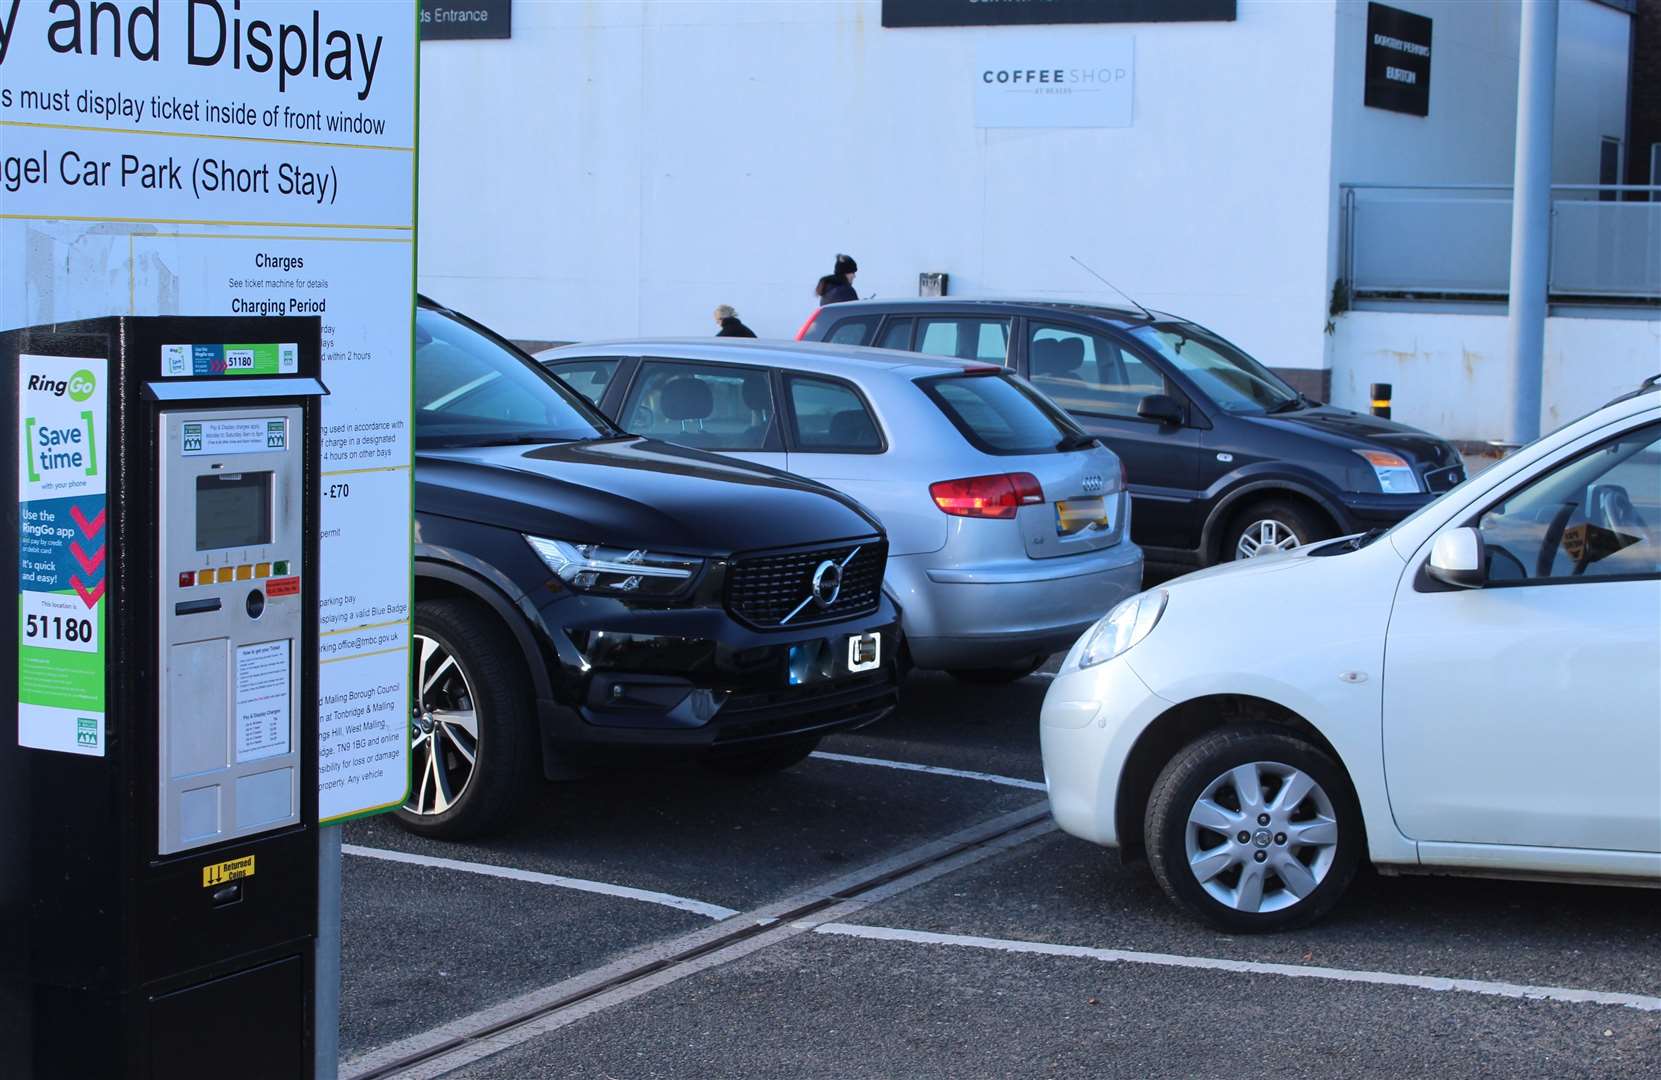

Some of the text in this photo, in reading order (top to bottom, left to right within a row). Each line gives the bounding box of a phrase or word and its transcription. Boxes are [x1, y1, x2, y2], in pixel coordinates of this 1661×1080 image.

[434, 8, 488, 22] Entrance
[47, 0, 160, 61] and
[187, 0, 383, 100] Display
[983, 68, 1126, 84] COFFEE SHOP
[20, 89, 70, 112] must
[76, 90, 145, 123] display
[151, 96, 200, 122] ticket
[206, 100, 257, 126] inside
[262, 105, 280, 128] of
[284, 106, 322, 131] front
[327, 112, 386, 135] window
[0, 150, 337, 205] gel Car Park (Short Stay)
[255, 253, 304, 271] Charges
[228, 278, 329, 288] See ticket machine for details
[232, 298, 326, 316] Charging Period
[321, 340, 334, 348] ays
[228, 357, 252, 369] 51180
[327, 351, 345, 361] within
[347, 351, 353, 361] 2
[354, 351, 371, 361] hours
[330, 424, 345, 433] used
[354, 421, 390, 432] accordance
[392, 420, 404, 429] with
[39, 427, 81, 446] Save
[325, 438, 347, 449] charge
[362, 434, 396, 446] designated
[40, 448, 82, 470] time
[330, 452, 348, 460] hours
[349, 451, 357, 459] on
[360, 449, 375, 458] other
[376, 448, 391, 458] bays
[55, 481, 66, 490] your
[68, 481, 87, 489] phone
[330, 484, 349, 498] £70
[22, 509, 55, 522] Use the
[22, 522, 74, 538] RingGo app
[320, 528, 341, 539] permit
[22, 559, 56, 572] It's quick
[22, 573, 57, 584] and easy!
[52, 601, 71, 609] location
[320, 594, 356, 607] parking bay
[356, 609, 370, 619] valid
[372, 606, 386, 616] Blue
[387, 603, 407, 615] Badge
[27, 614, 92, 643] 51180
[325, 693, 348, 705] Malling
[349, 688, 375, 701] Borough
[377, 683, 400, 695] Council
[326, 713, 332, 722] at
[334, 705, 365, 719] Tonbridge
[366, 705, 371, 713] &
[373, 701, 395, 712] Malling
[346, 725, 361, 734] West
[337, 742, 351, 753] TN9
[352, 739, 366, 750] 1BG
[368, 736, 379, 746] and
[381, 733, 400, 743] online
[342, 760, 352, 768] for
[353, 757, 365, 766] loss
[375, 750, 400, 762] damage
[348, 775, 360, 784] Any
[362, 768, 384, 780] vehicle
[224, 858, 251, 872] Returned
[229, 869, 247, 880] Coins
